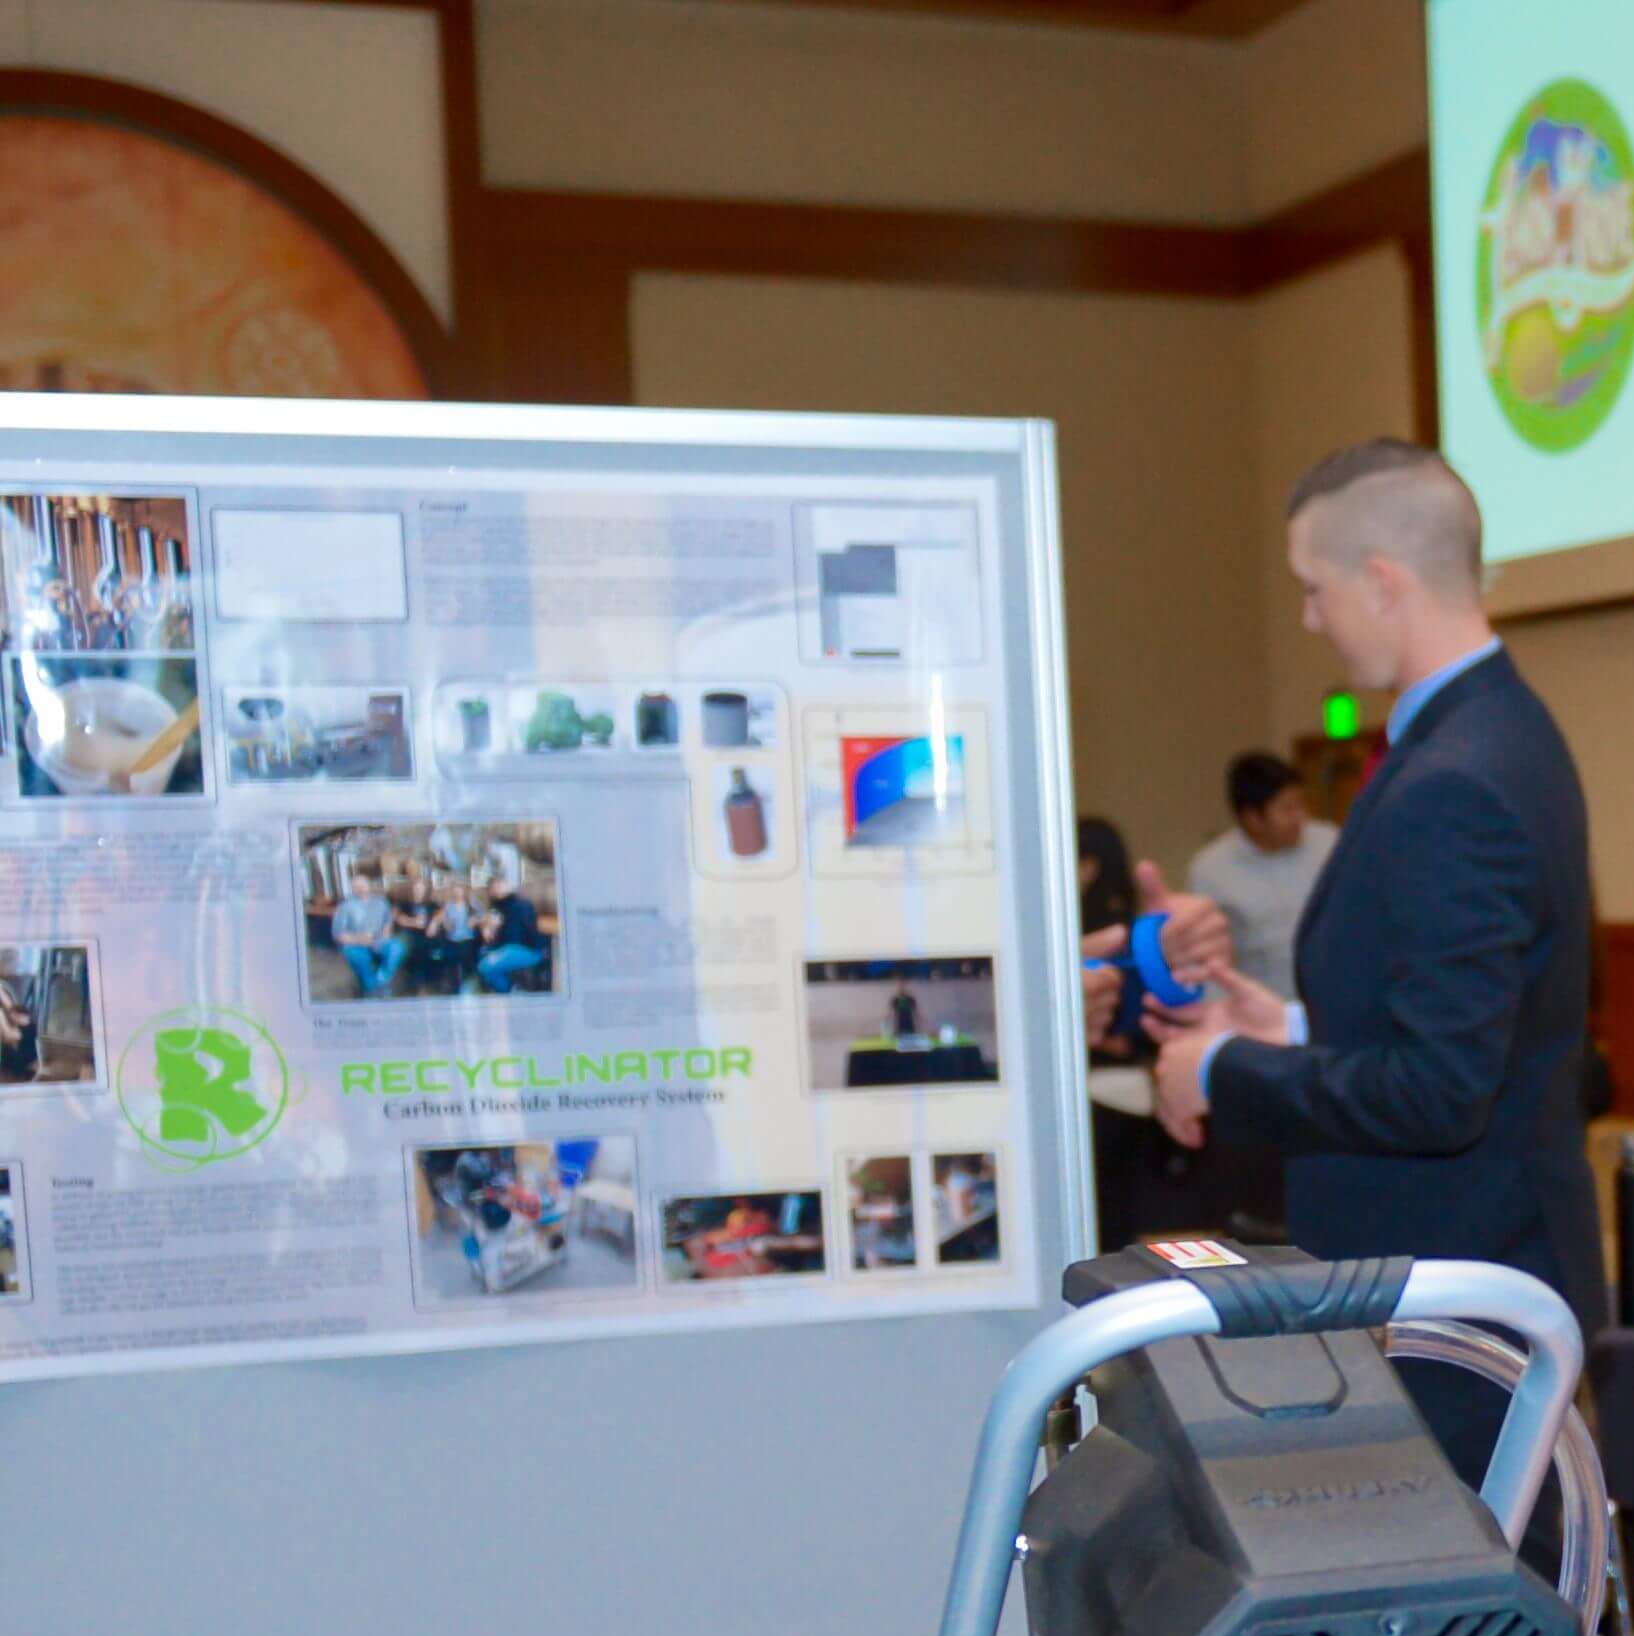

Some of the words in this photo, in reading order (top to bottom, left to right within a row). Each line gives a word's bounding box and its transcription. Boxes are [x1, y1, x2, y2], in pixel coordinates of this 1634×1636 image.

[340, 1046, 753, 1097] RECYCLINATOR
[383, 1101, 463, 1120] Carbon
[558, 1092, 651, 1113] Recovery
[655, 1086, 726, 1107] System
